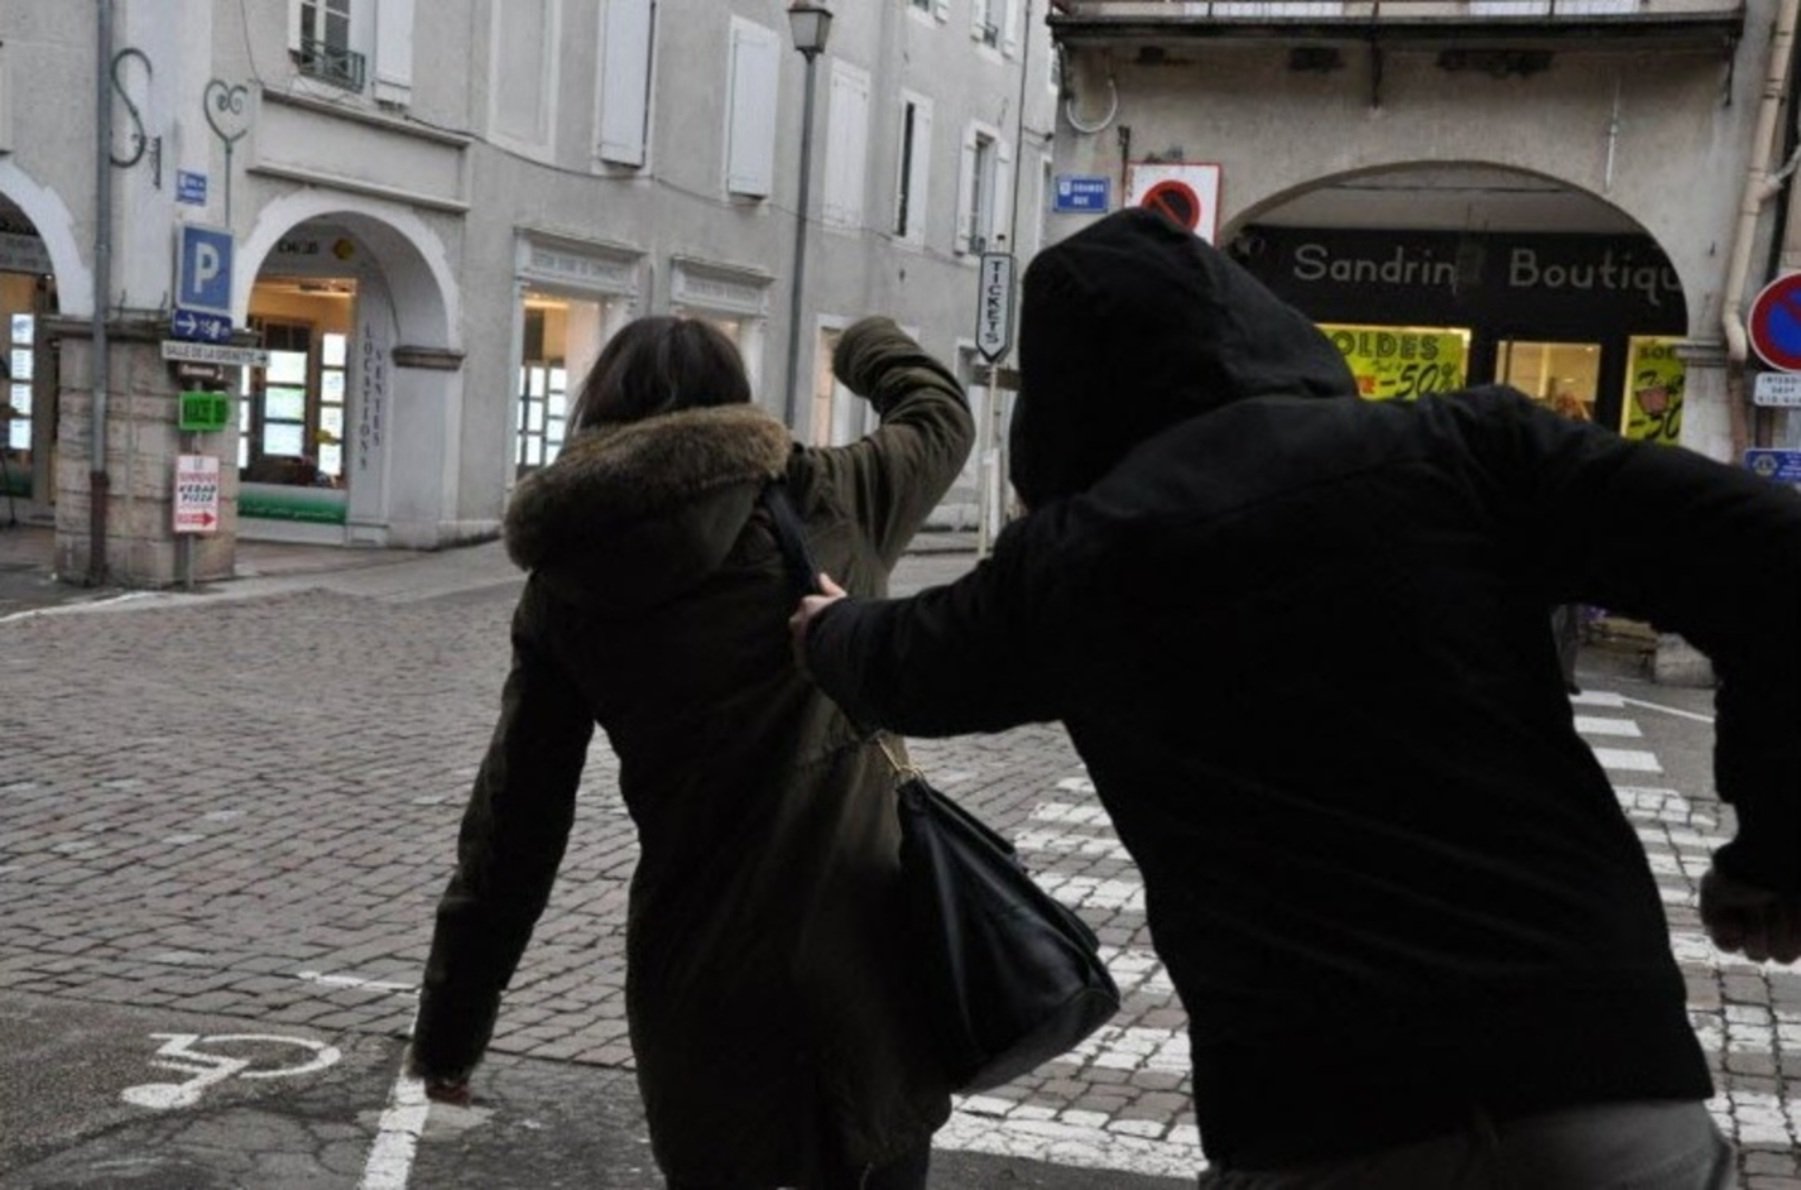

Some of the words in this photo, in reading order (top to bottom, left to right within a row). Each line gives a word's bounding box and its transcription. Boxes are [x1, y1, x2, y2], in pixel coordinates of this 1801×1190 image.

[193, 240, 220, 294] P
[1294, 243, 1458, 284] Sandrin
[1509, 247, 1683, 306] Boutiqu
[985, 260, 1003, 345] TICKETS
[1331, 332, 1439, 360] OLDES
[1629, 402, 1684, 438] -50
